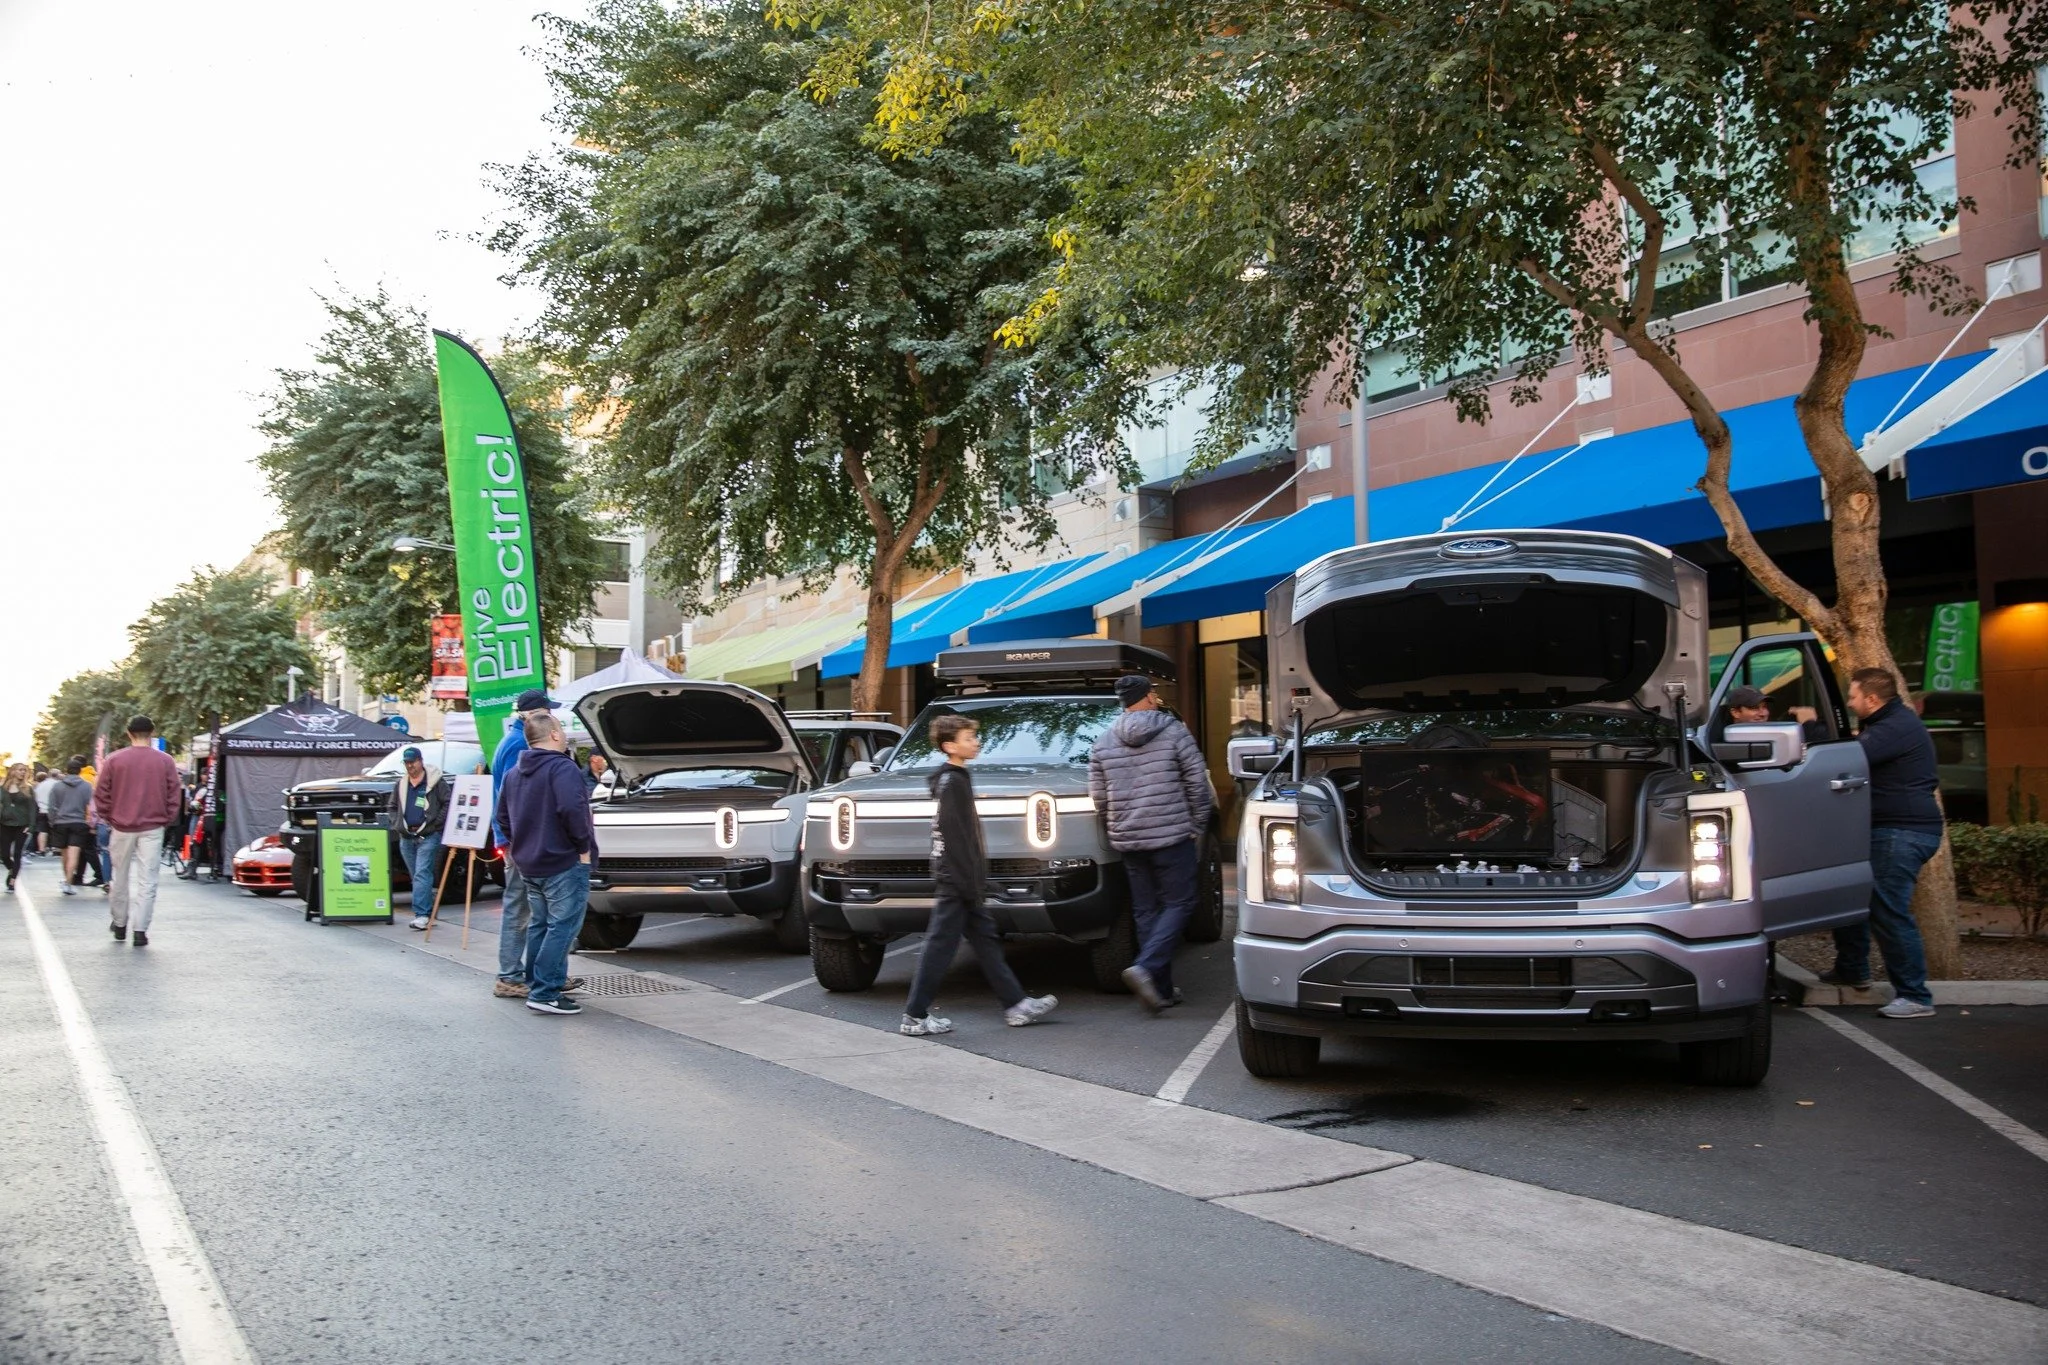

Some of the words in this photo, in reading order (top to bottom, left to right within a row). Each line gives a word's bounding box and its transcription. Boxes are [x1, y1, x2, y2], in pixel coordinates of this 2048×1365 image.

[476, 433, 534, 680] Electric!
[473, 587, 499, 683] Drive
[227, 739, 272, 749] SURVIVE
[273, 740, 315, 749] DEADLY
[316, 741, 351, 749] FORCE
[351, 741, 412, 749] ENCOUNT
[347, 845, 377, 853] Owners
